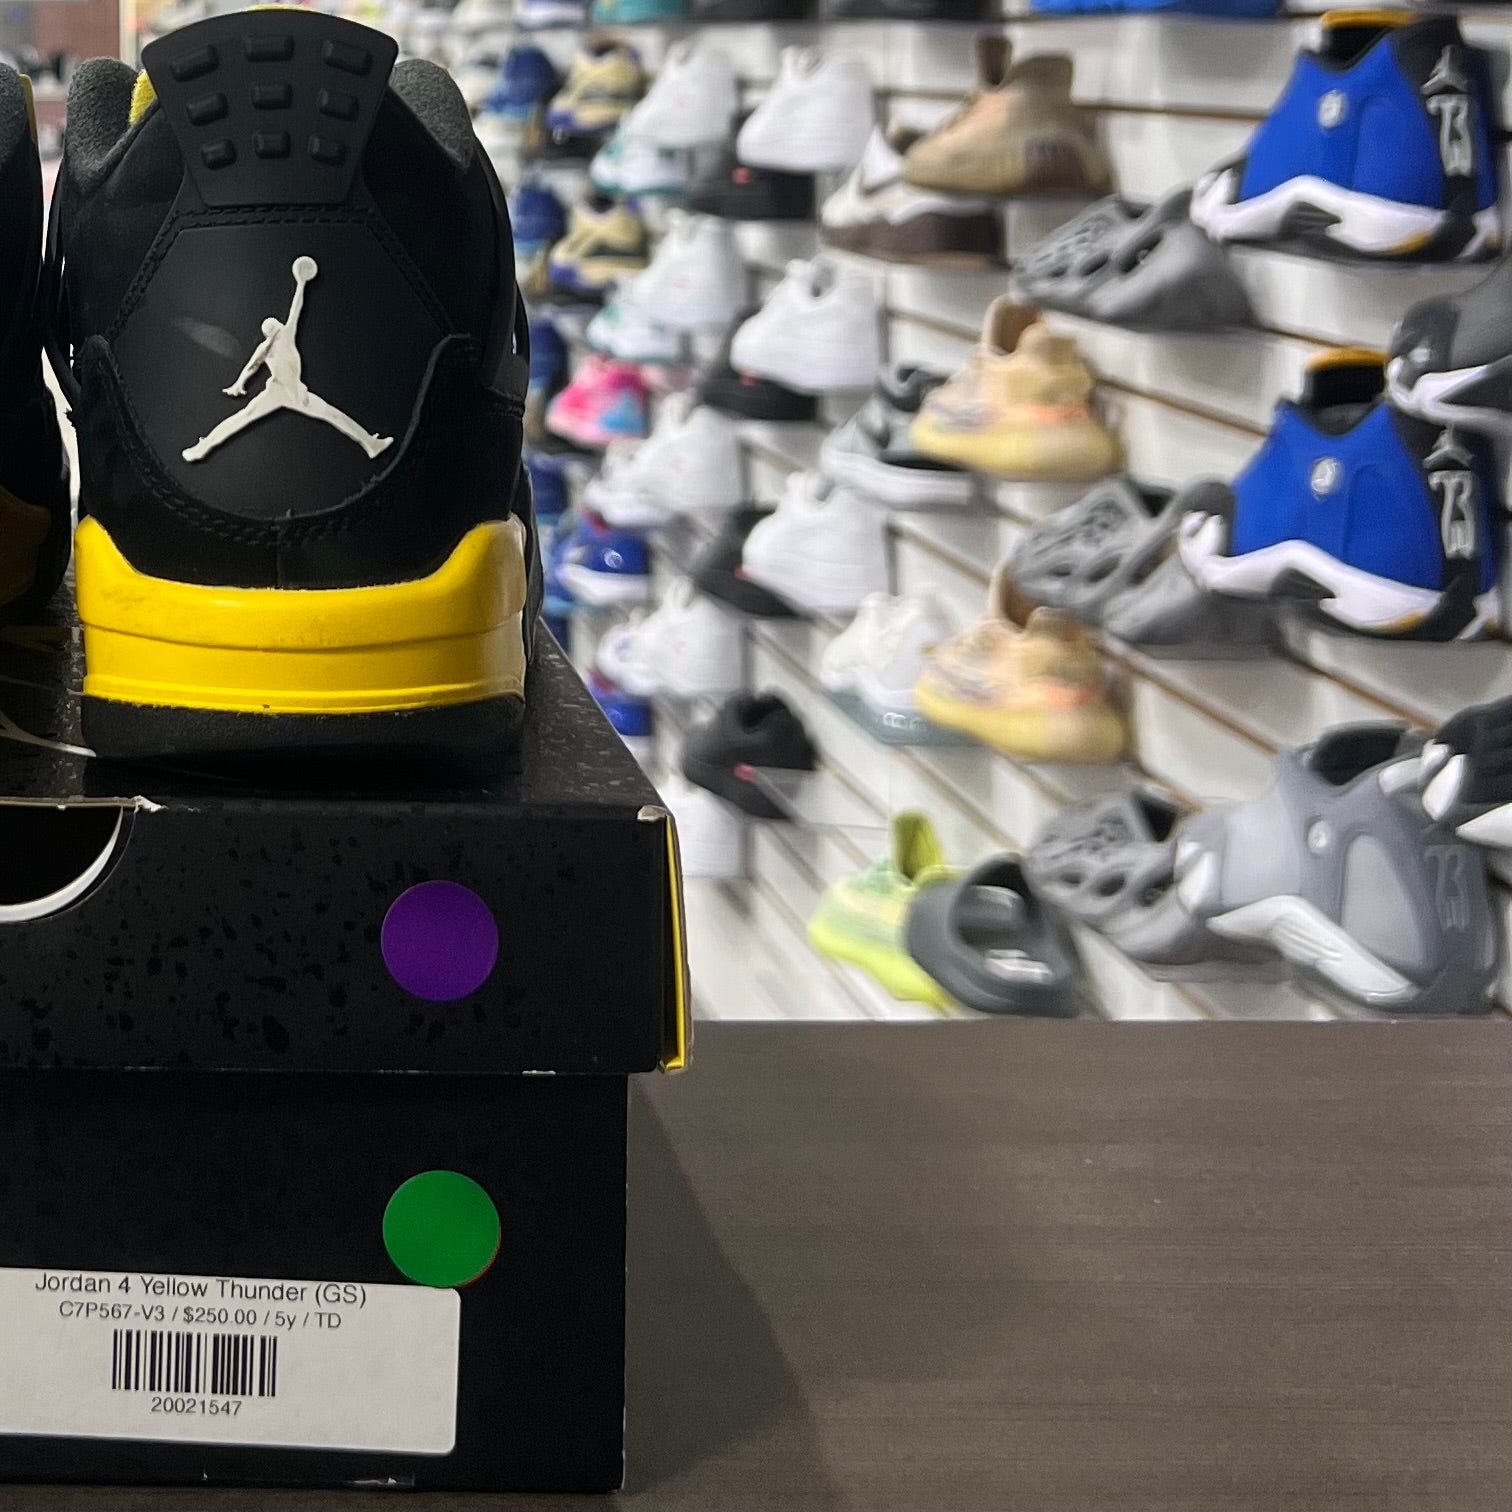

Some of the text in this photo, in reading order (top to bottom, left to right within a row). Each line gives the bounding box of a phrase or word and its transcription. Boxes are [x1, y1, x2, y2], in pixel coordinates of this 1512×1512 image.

[35, 1272, 366, 1309] Jordan 4 Yellow Thunder (GS)
[59, 1300, 342, 1330] C7P567-V3 / $250.00 / 5y / TD
[151, 1395, 242, 1417] 20021547
